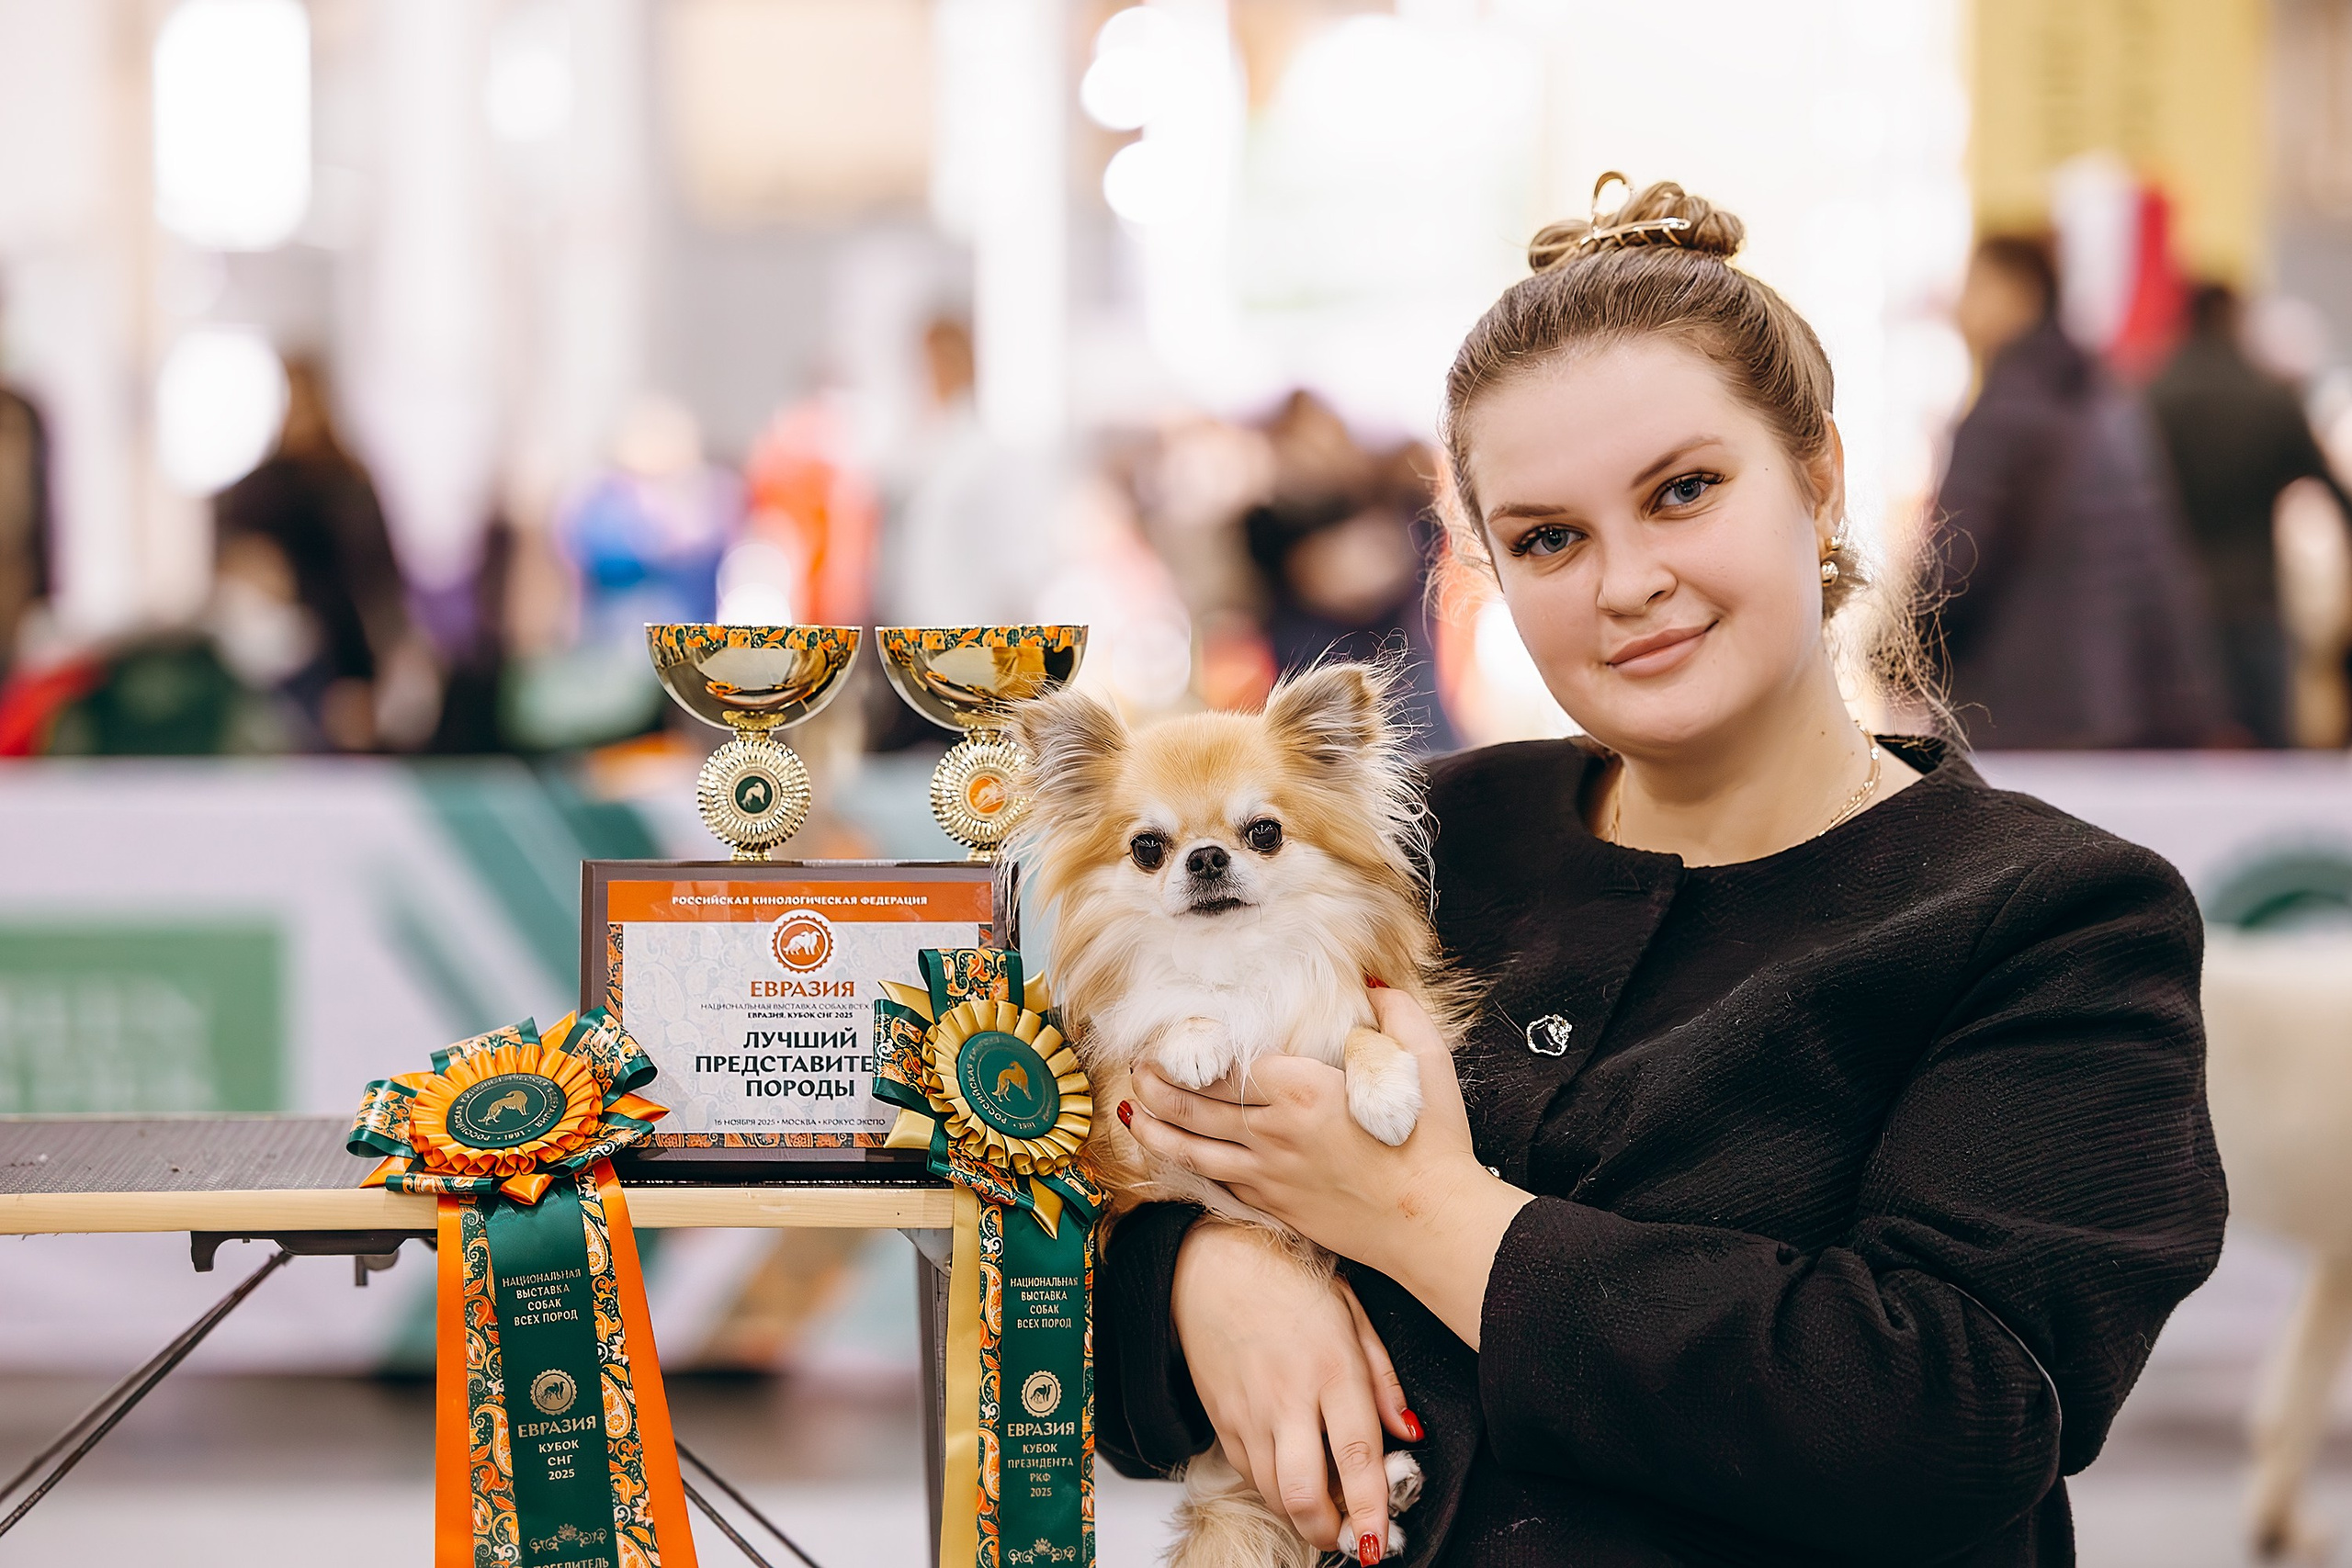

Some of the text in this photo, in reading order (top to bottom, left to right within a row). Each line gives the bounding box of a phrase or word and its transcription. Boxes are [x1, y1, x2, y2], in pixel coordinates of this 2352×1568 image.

[672, 895, 928, 906] РОССИЙСКАЯ КИНОЛОГИЧЕСКАЯ ФЕДЕРАЦИЯ
[751, 981, 854, 998] ЕВРАЗИЯ
[743, 1027, 857, 1049] ЛУЧШИЙ
[695, 1055, 873, 1077] ПРЕДСТАВИТЕ
[746, 1079, 854, 1100] ПОРОДЫ
[967, 1063, 1008, 1124] РОССИЙСКАЯ
[723, 1118, 756, 1126] НОЯБРЯ
[757, 1118, 775, 1126] 2025
[781, 1118, 817, 1126] МОСКВА
[822, 1118, 855, 1126] КРОКУС
[856, 1118, 886, 1126] ЭКСПО
[502, 1269, 582, 1288] НАЦИОНАЛЬНАЯ
[1010, 1277, 1079, 1288] НАЦИОНАЛЬНАЯ
[515, 1283, 570, 1299] ВЫСТАВКА
[1021, 1291, 1068, 1301] ВЫСТАВКА
[527, 1298, 561, 1311] СОБАК
[1029, 1304, 1059, 1314] СОБАК
[514, 1309, 579, 1326] ВСЕХ ПОРОД
[1017, 1317, 1072, 1329] ВСЕХ ПОРОД
[517, 1415, 596, 1438] ЕВРАЗИЯ
[1007, 1421, 1075, 1437] ЕВРАЗИЯ
[538, 1439, 580, 1453] КУБОК
[1023, 1443, 1057, 1454] КУБОК
[547, 1454, 573, 1466] СНГ
[1007, 1458, 1074, 1469] ПРЕЗИДЕНТА
[548, 1468, 575, 1481] 2025
[1029, 1472, 1051, 1483] РКФ
[1030, 1487, 1053, 1497] 2025
[533, 1557, 609, 1568] ЕДИТЕЛЬ
